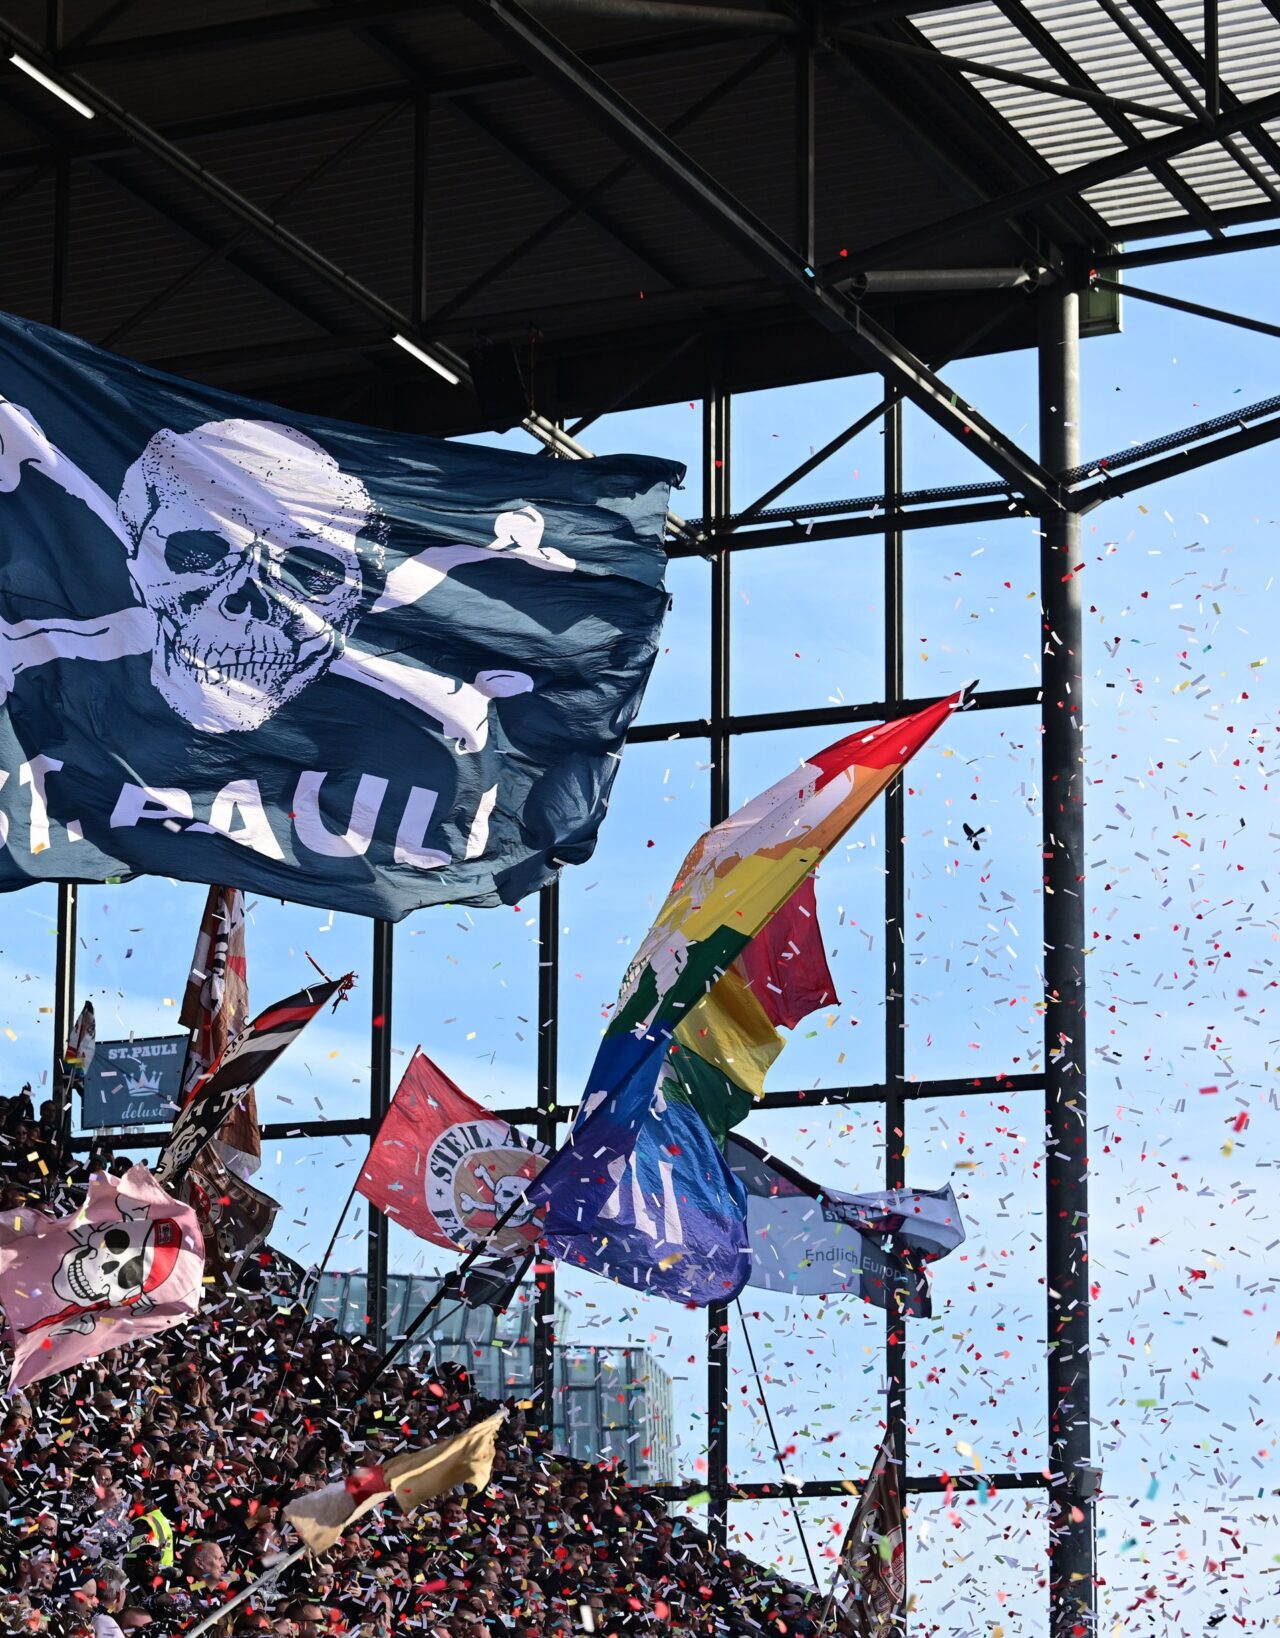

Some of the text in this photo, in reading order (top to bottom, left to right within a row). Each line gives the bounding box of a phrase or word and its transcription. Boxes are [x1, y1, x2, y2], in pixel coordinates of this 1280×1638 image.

[110, 770, 498, 869] PAULI
[132, 1043, 177, 1058] PAULI
[430, 1125, 493, 1185] STEIL
[805, 1247, 858, 1265] Endlich
